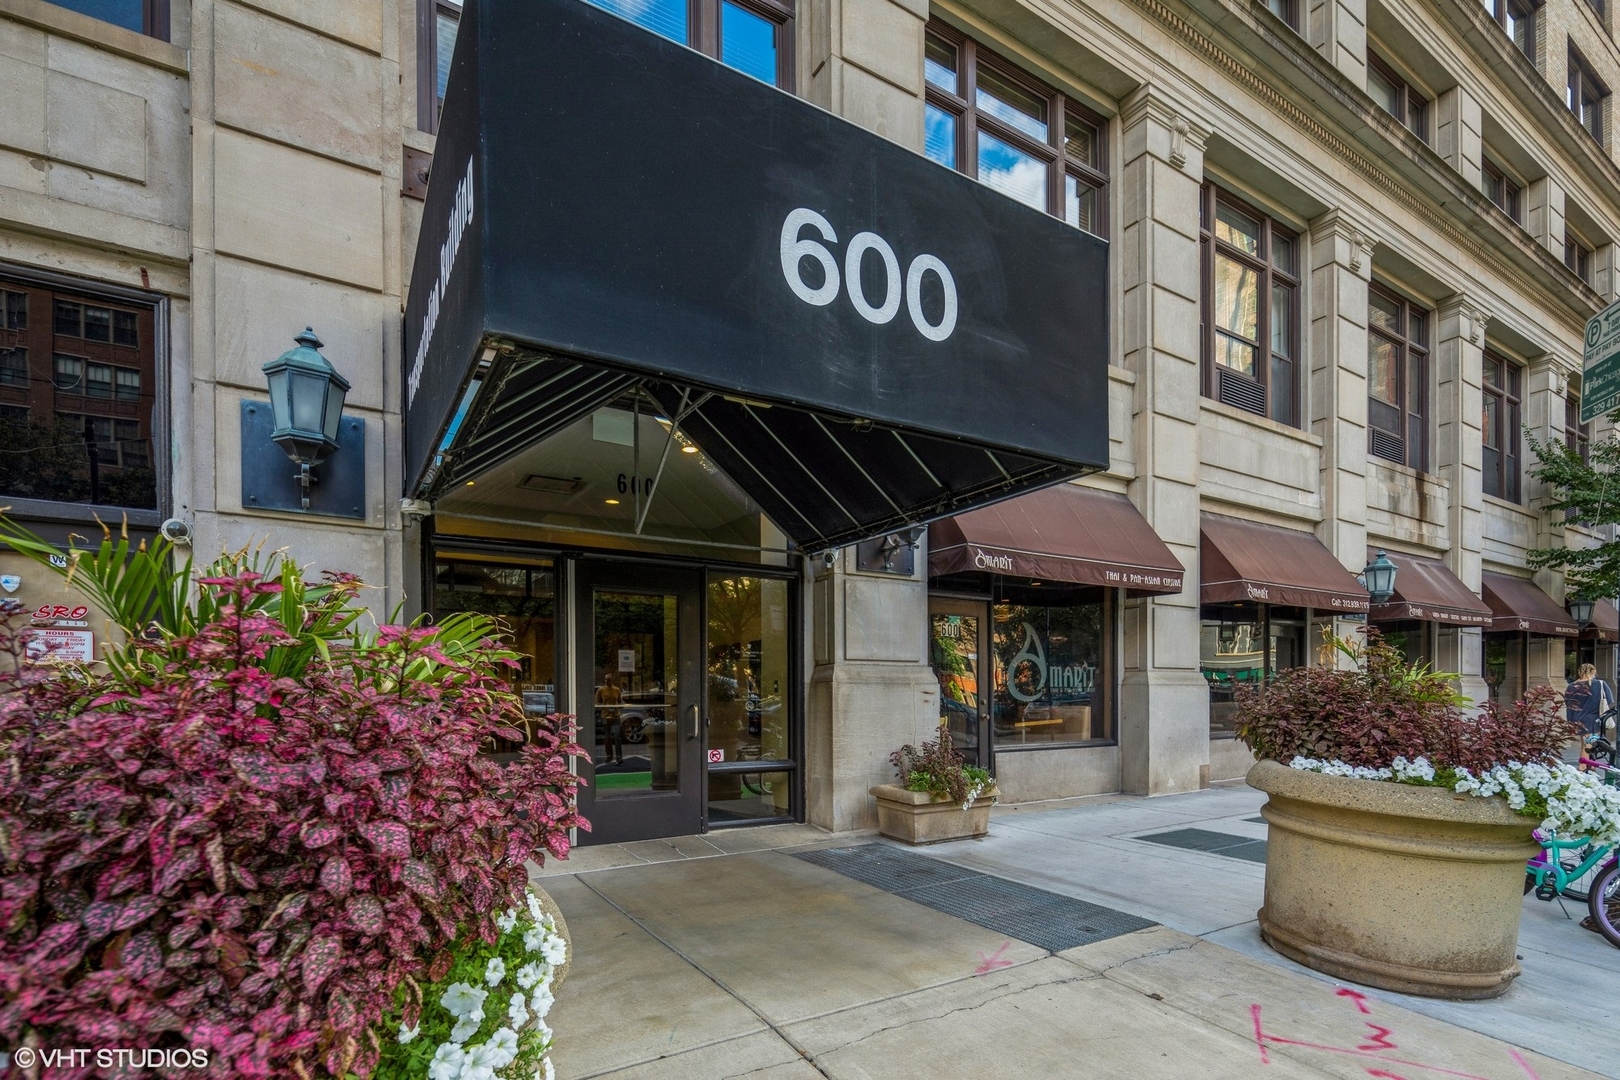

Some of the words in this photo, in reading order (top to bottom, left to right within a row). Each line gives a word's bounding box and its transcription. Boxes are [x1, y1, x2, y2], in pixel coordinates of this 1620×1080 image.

[440, 153, 474, 300] Building
[779, 207, 958, 341] 600
[1590, 369, 1620, 390] ParkChicag
[1105, 571, 1120, 581] THAI
[1122, 573, 1127, 582] &
[1130, 574, 1160, 585] PAN-ASIAN
[31, 604, 88, 619] SRO
[941, 623, 959, 636] 600
